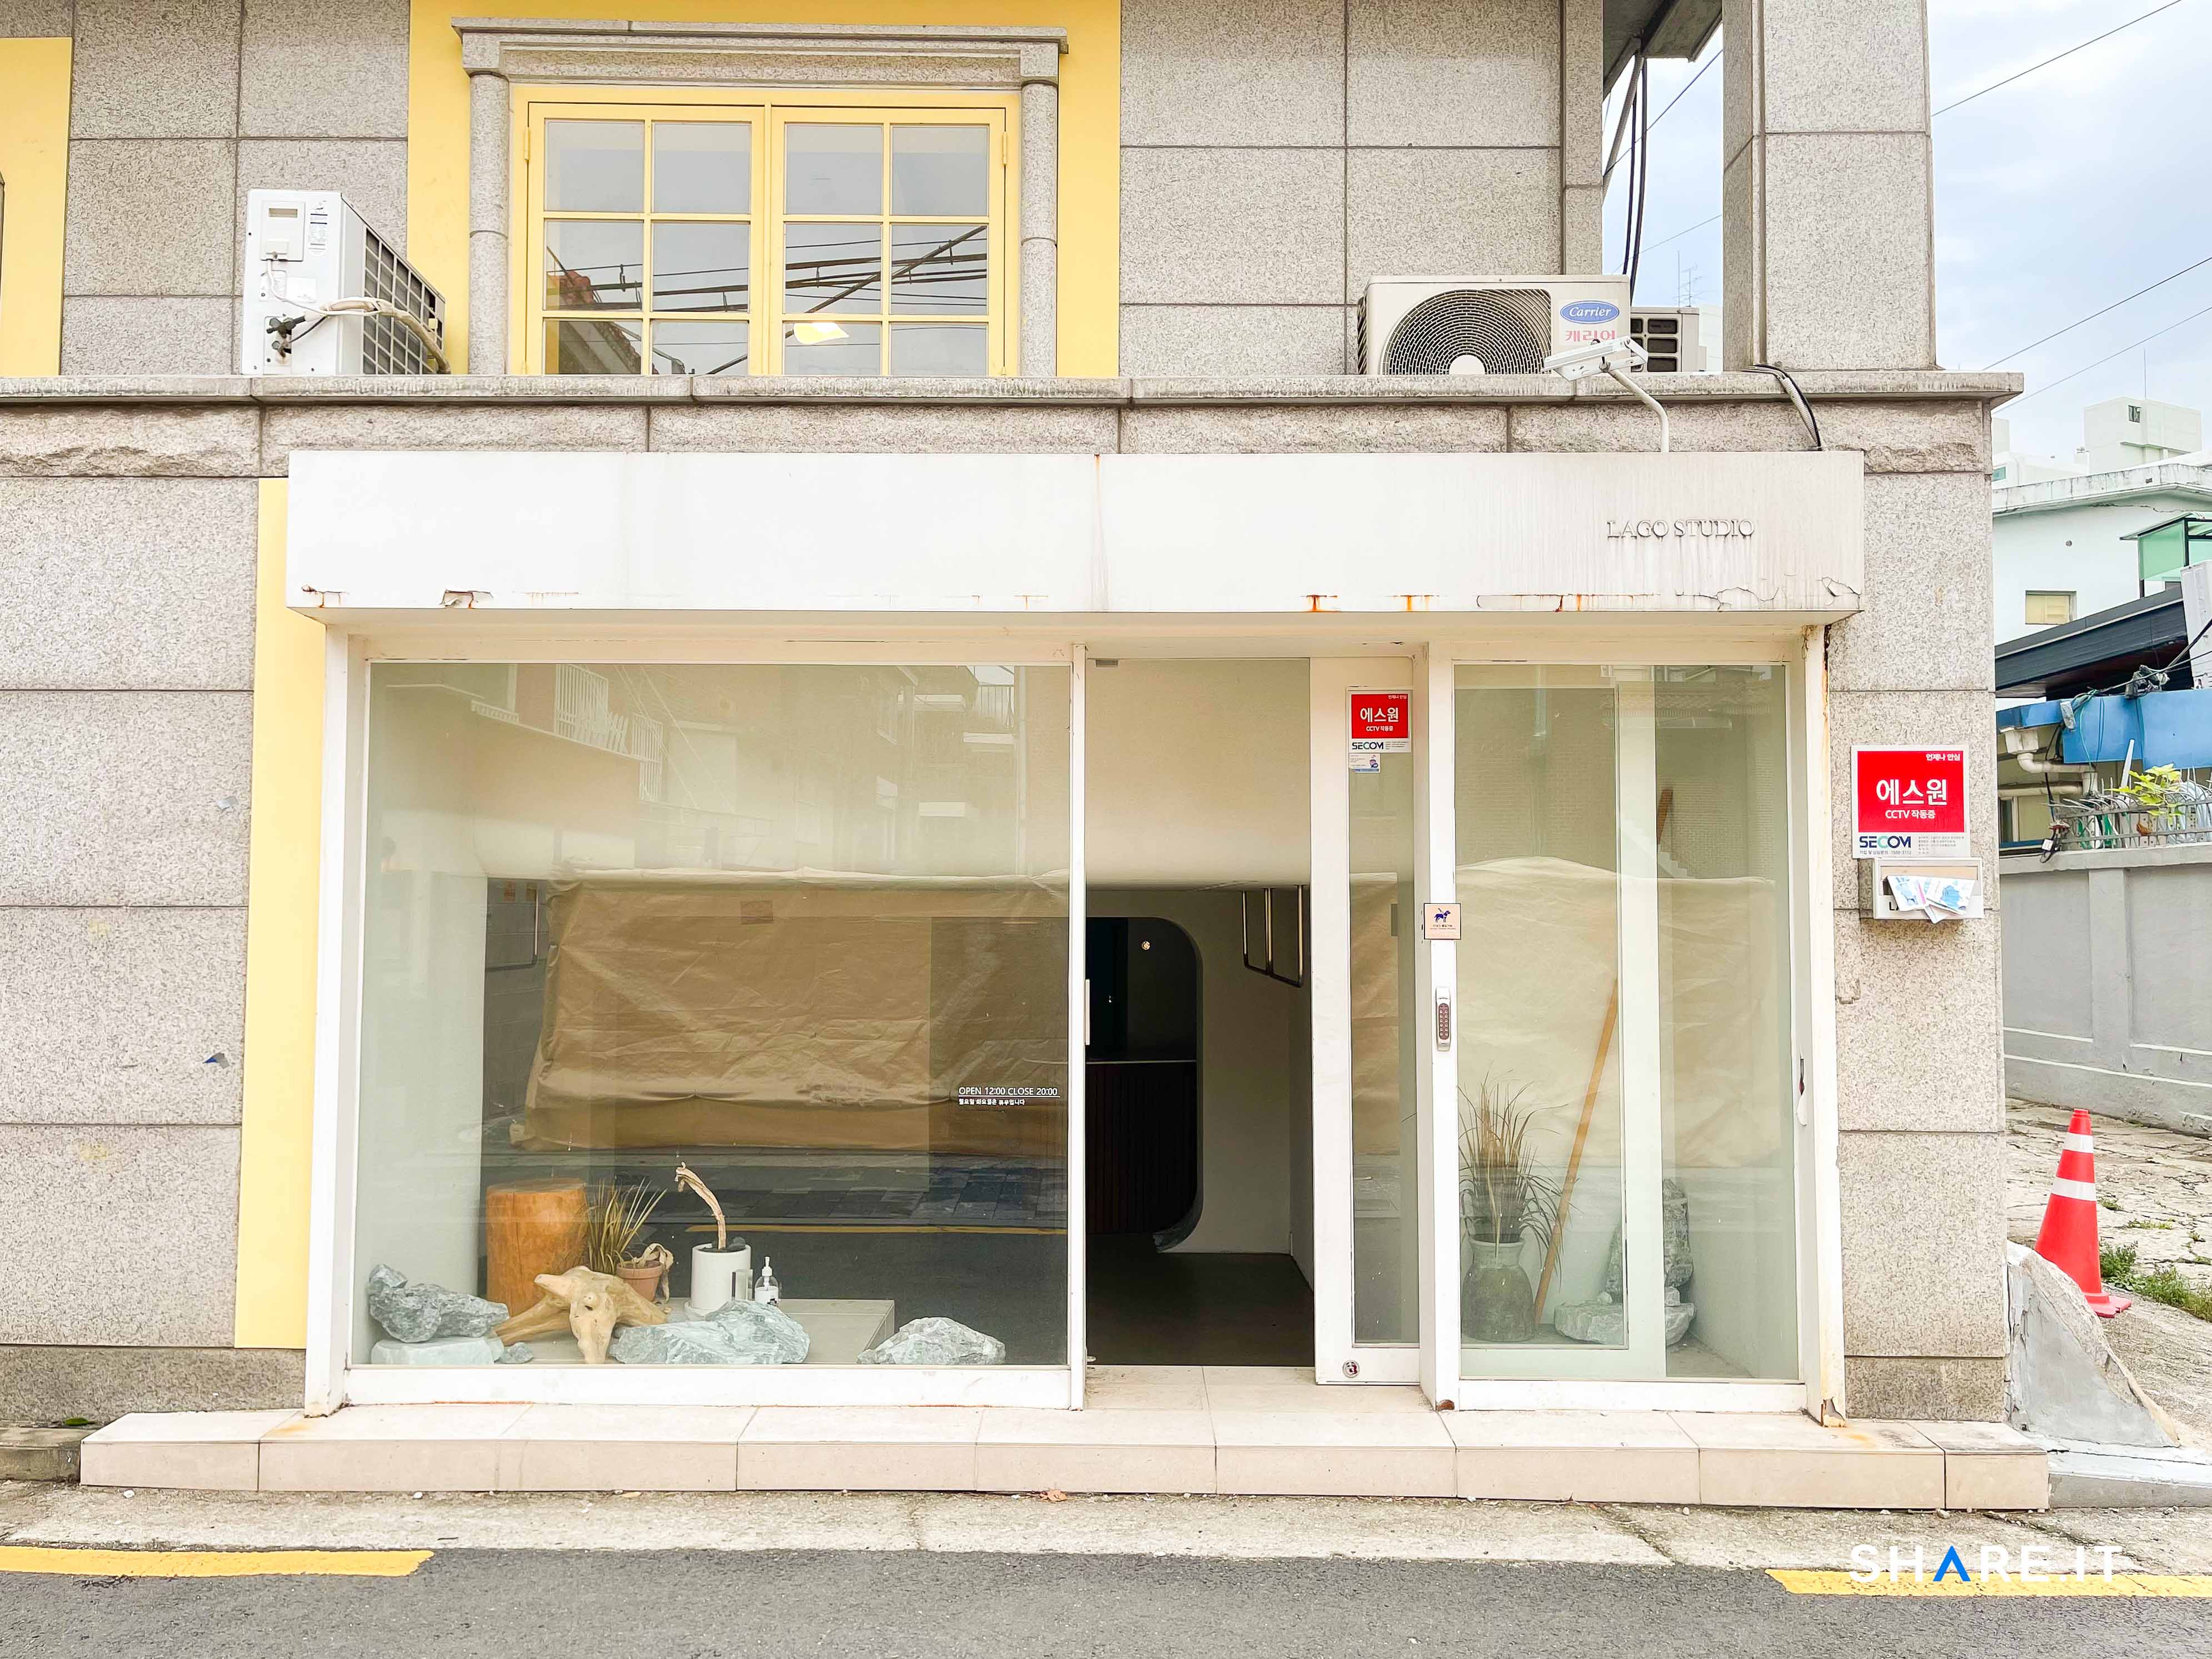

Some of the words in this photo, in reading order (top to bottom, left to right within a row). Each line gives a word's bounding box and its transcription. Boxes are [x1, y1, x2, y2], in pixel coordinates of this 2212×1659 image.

[1569, 306, 1612, 317] Carrier
[1565, 329, 1616, 342] 캐리어
[1607, 519, 1669, 538] LAGO
[1673, 519, 1755, 537] STUDIO
[1360, 707, 1399, 723] 에스원
[1352, 741, 1384, 750] SECOM
[1876, 779, 1947, 805] 에스원
[1885, 810, 1910, 819] CCTV
[1911, 809, 1936, 819] 작동중
[1859, 835, 1912, 849] SECOM
[959, 1087, 982, 1095] OPEN
[1036, 1088, 1058, 1096] 20:00
